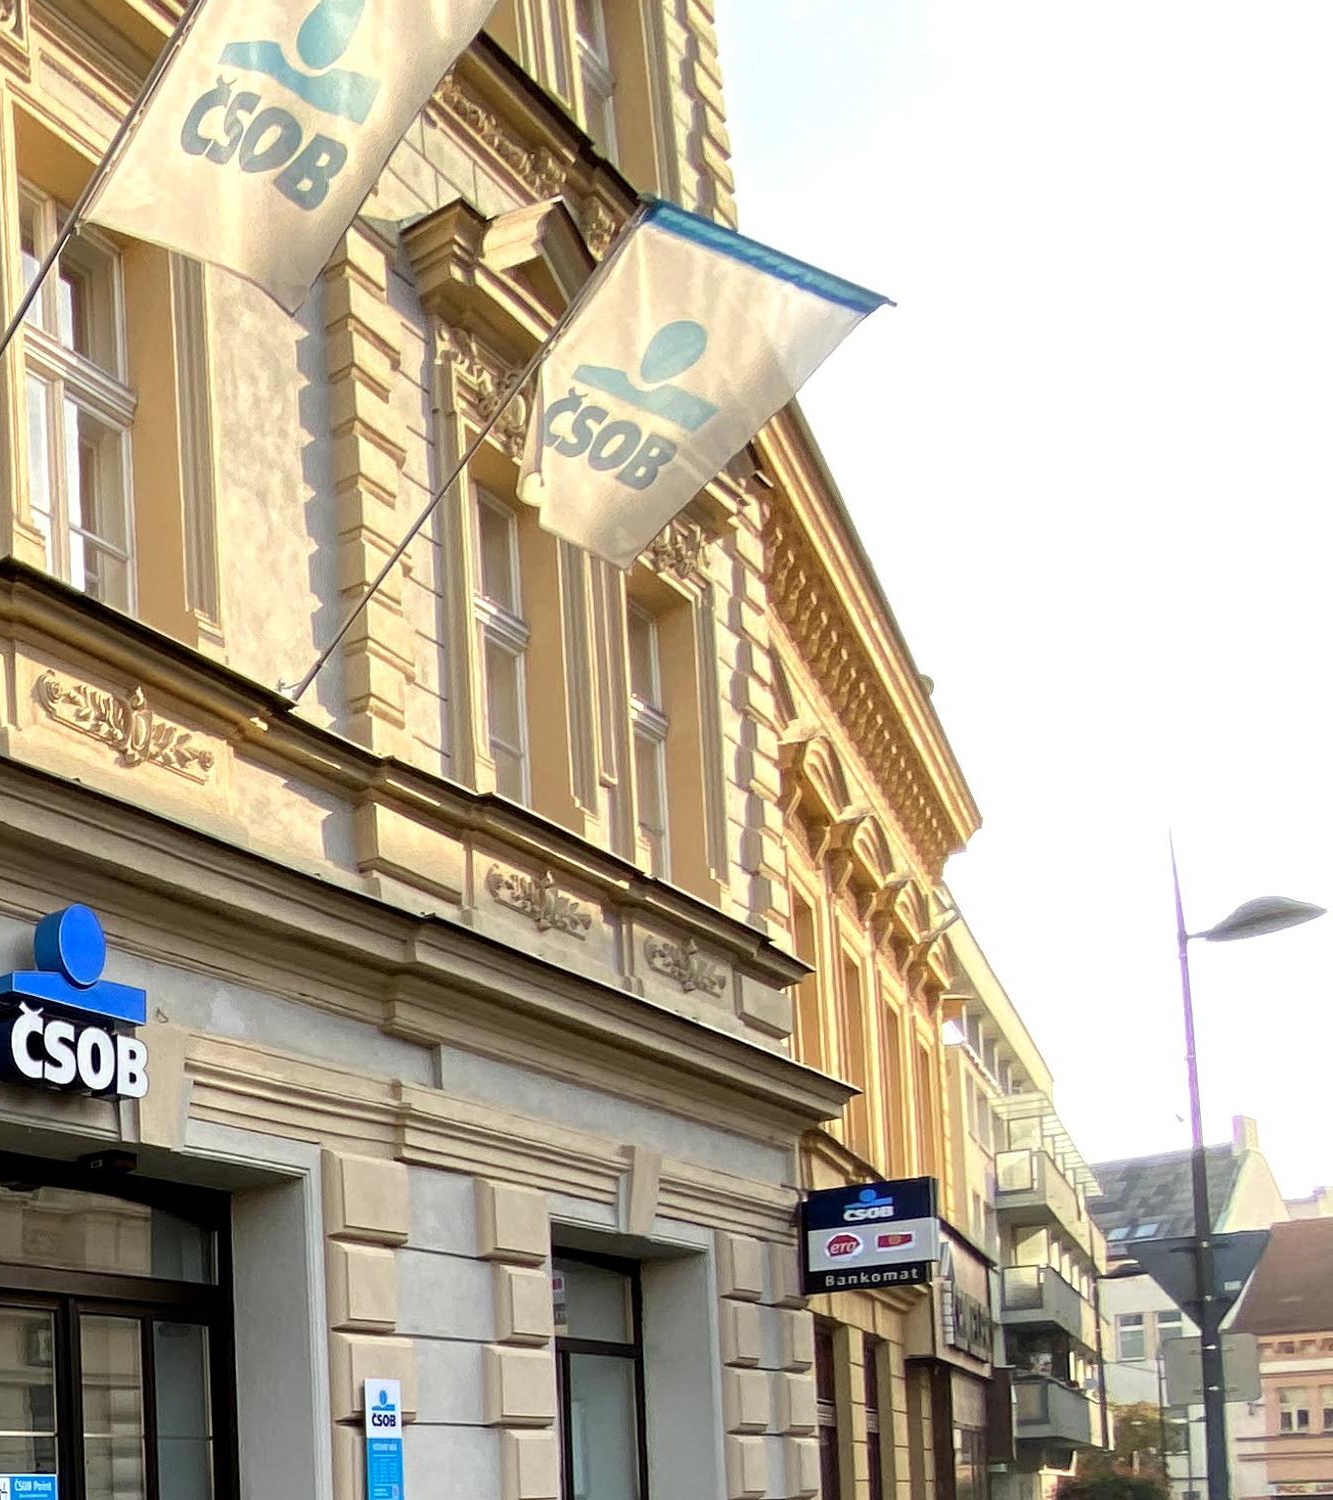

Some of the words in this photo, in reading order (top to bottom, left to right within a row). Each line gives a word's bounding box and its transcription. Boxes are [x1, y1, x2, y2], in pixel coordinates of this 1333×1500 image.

[180, 74, 348, 211] ČSOB
[543, 387, 678, 490] ČSOB
[11, 1001, 149, 1098] ČSOB
[825, 1267, 919, 1287] Bankomat
[372, 1413, 396, 1427] ČSOB
